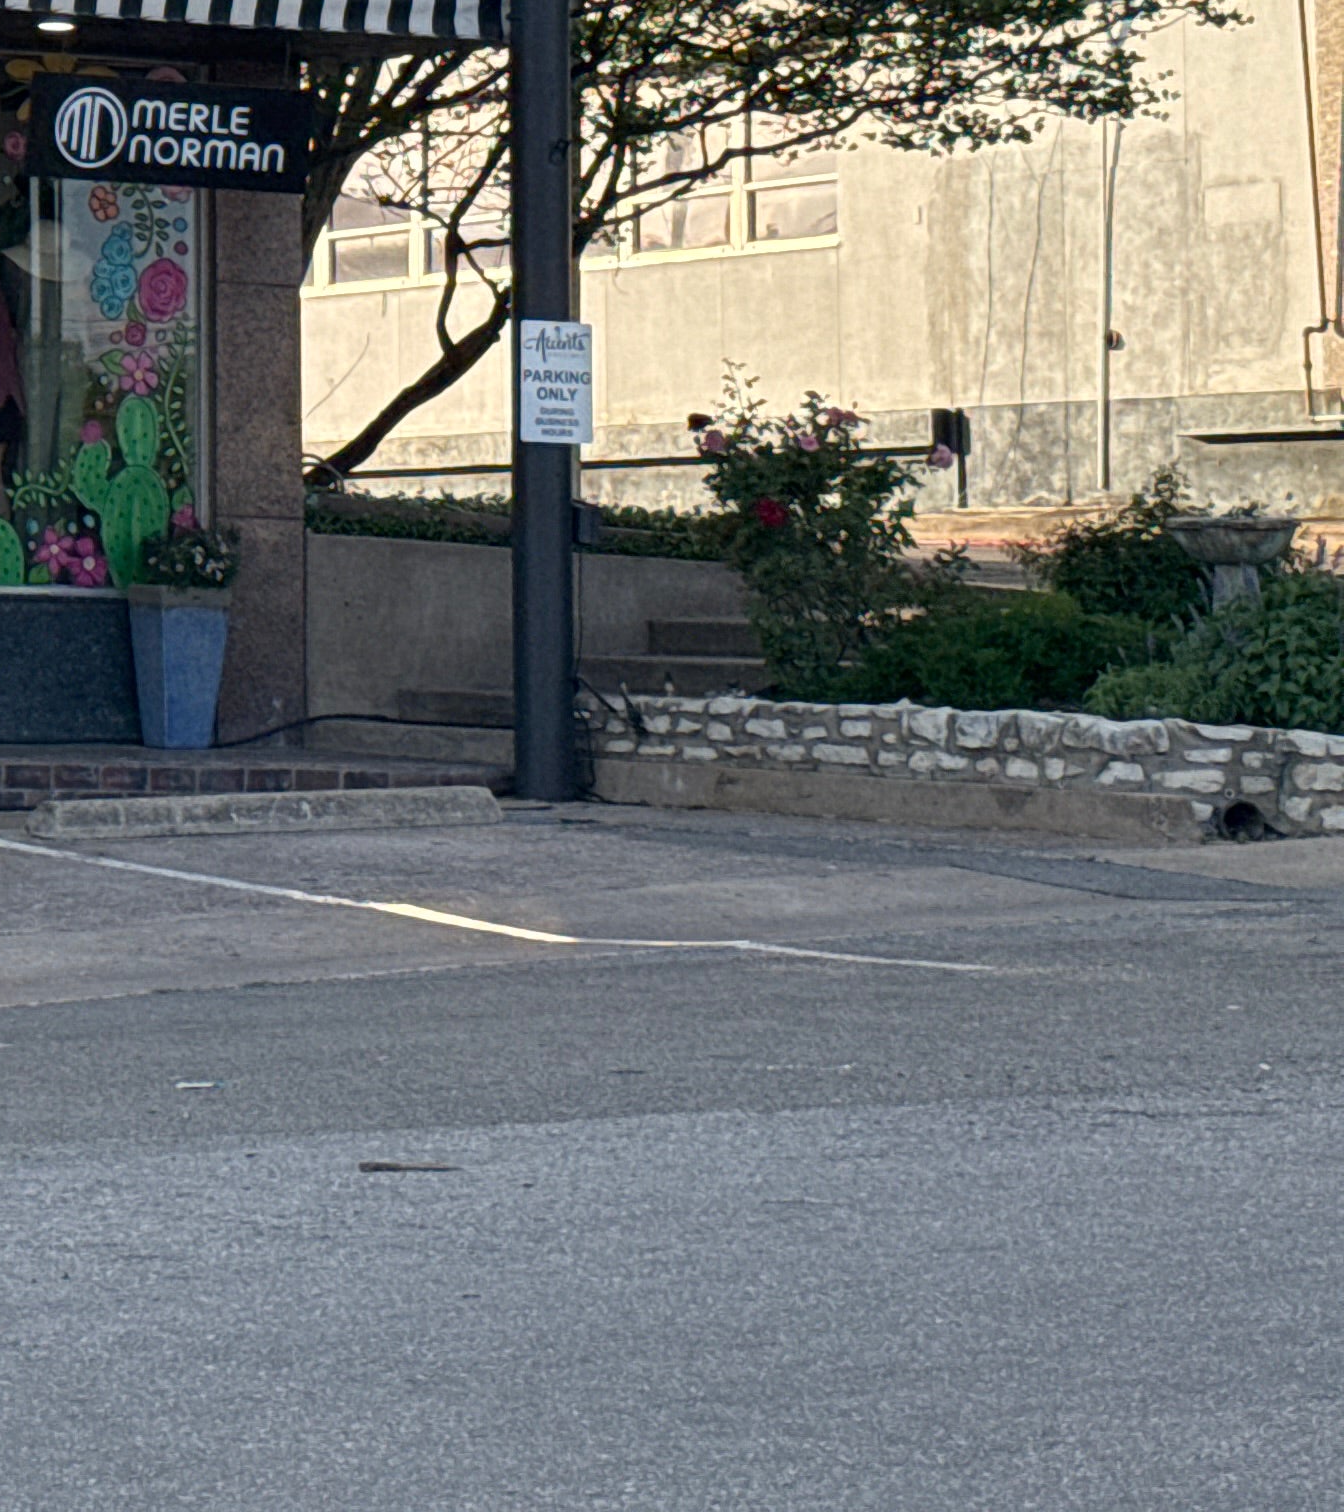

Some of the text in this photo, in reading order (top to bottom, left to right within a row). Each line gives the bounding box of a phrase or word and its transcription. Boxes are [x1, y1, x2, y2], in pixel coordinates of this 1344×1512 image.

[132, 99, 251, 136] MERLE
[128, 134, 285, 173] NORMAN
[524, 328, 590, 363] Accents
[523, 369, 591, 385] PARKING
[537, 387, 578, 402] ONLY
